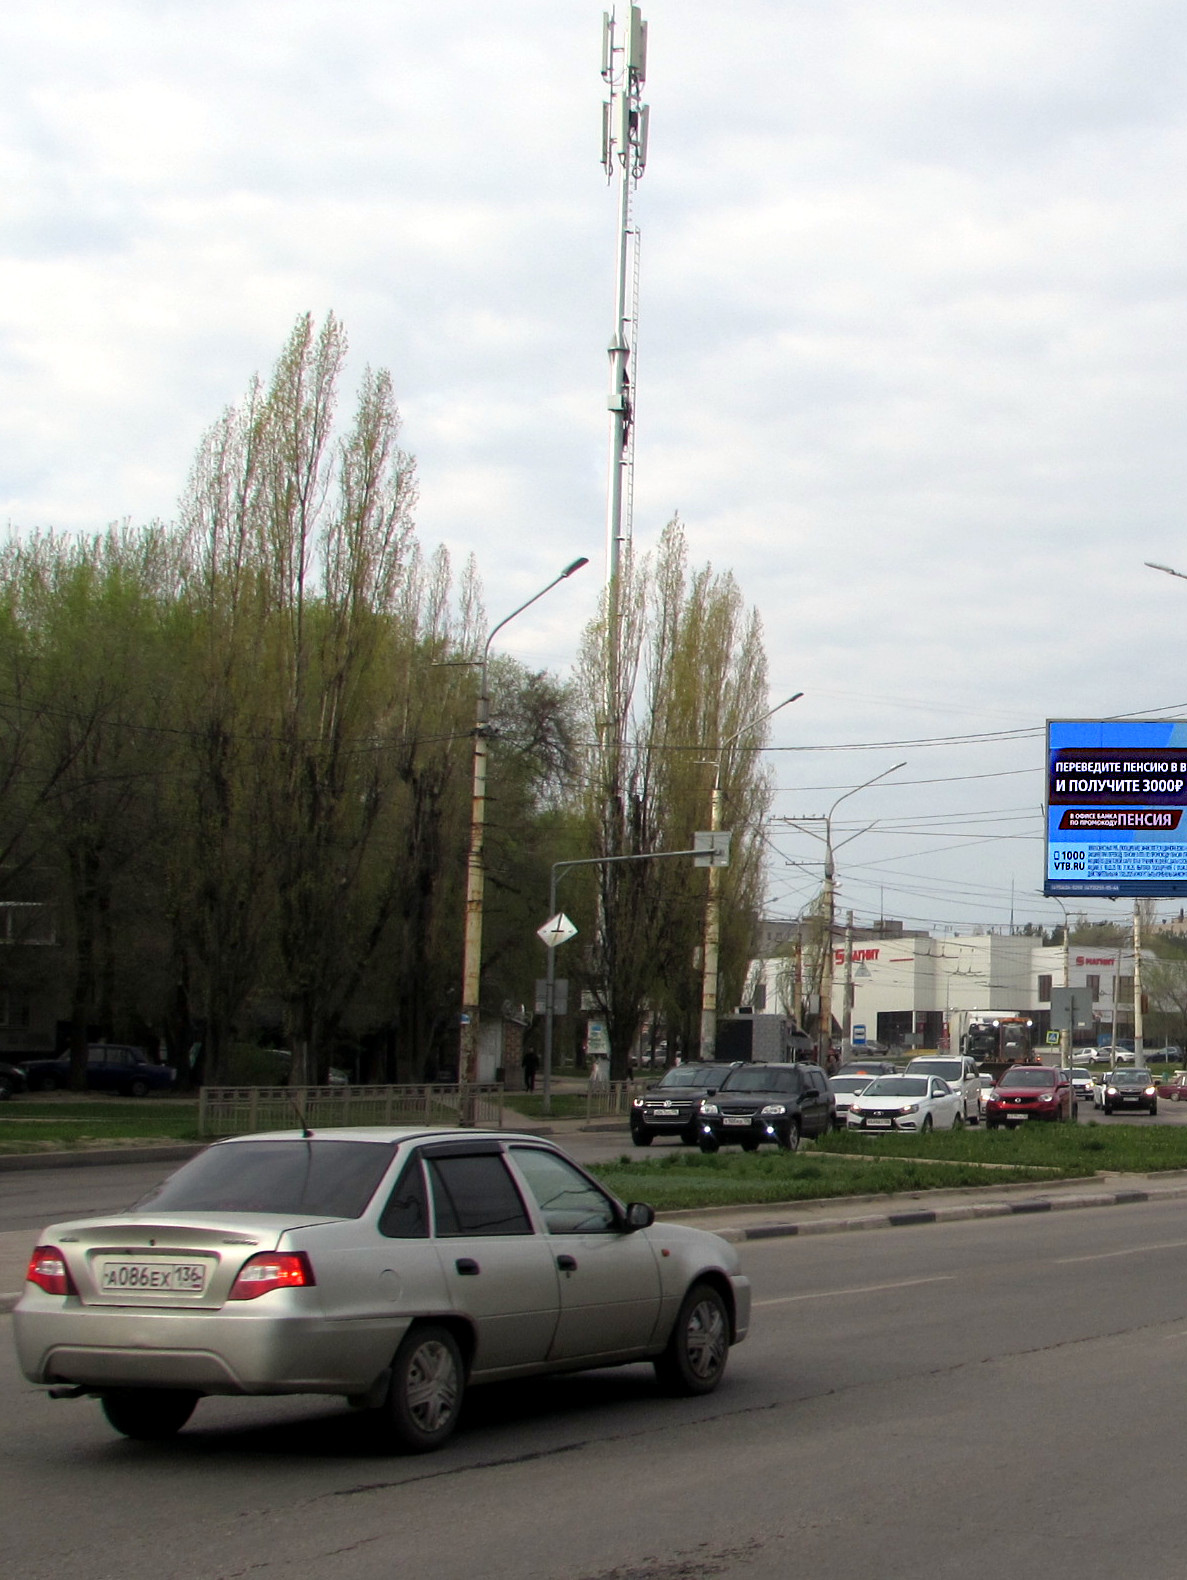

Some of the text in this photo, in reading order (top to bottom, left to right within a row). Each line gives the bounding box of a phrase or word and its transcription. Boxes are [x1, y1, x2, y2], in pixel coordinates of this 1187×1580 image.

[1055, 762, 1121, 774] ПЕРЕВЕДИТЕ
[1123, 762, 1169, 773] ПЕНСИЮ
[1170, 762, 1178, 773] В
[1055, 779, 1066, 792] И
[1069, 779, 1139, 793] ПОЛУЧИТЕ
[1118, 813, 1172, 826] ПЕНСИЯ
[1063, 851, 1085, 860] 1000
[1054, 862, 1085, 871] VTB.RU
